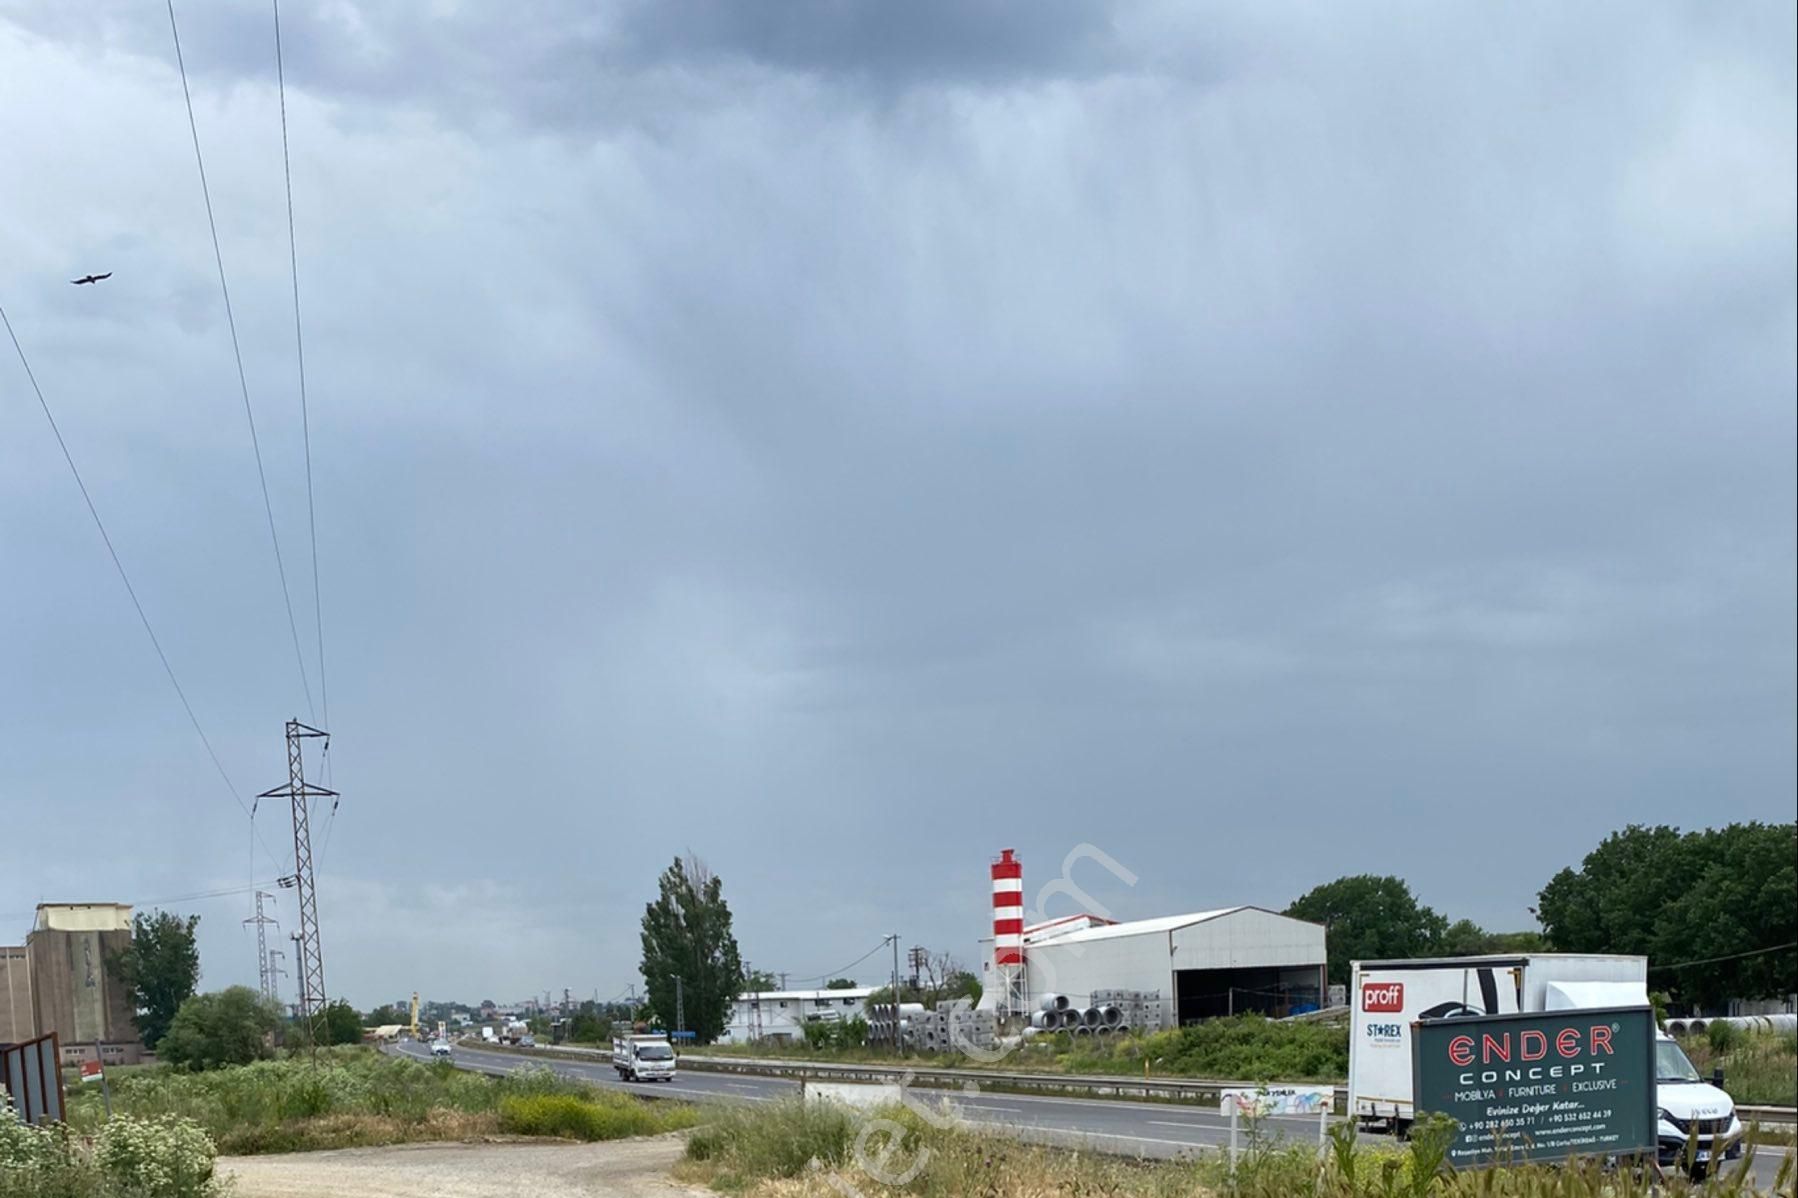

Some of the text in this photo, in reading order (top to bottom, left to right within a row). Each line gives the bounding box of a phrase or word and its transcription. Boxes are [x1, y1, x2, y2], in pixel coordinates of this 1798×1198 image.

[1364, 985, 1401, 1010] proff
[1448, 1025, 1614, 1067] ENDER
[1459, 1062, 1605, 1085] CONCEPT
[1455, 1079, 1617, 1102] MOBİLYA FURNITURE EXCLUSIVE
[1469, 1121, 1484, 1130] +90
[1516, 1117, 1525, 1126] 35
[1527, 1116, 1535, 1125] 71
[1549, 1114, 1563, 1123] +90
[1564, 1113, 1577, 1122] 532
[1593, 1110, 1602, 1119] 44
[1603, 1109, 1612, 1118] 39
[1486, 1106, 1519, 1116] Evinize
[1522, 1102, 1550, 1115] Değer
